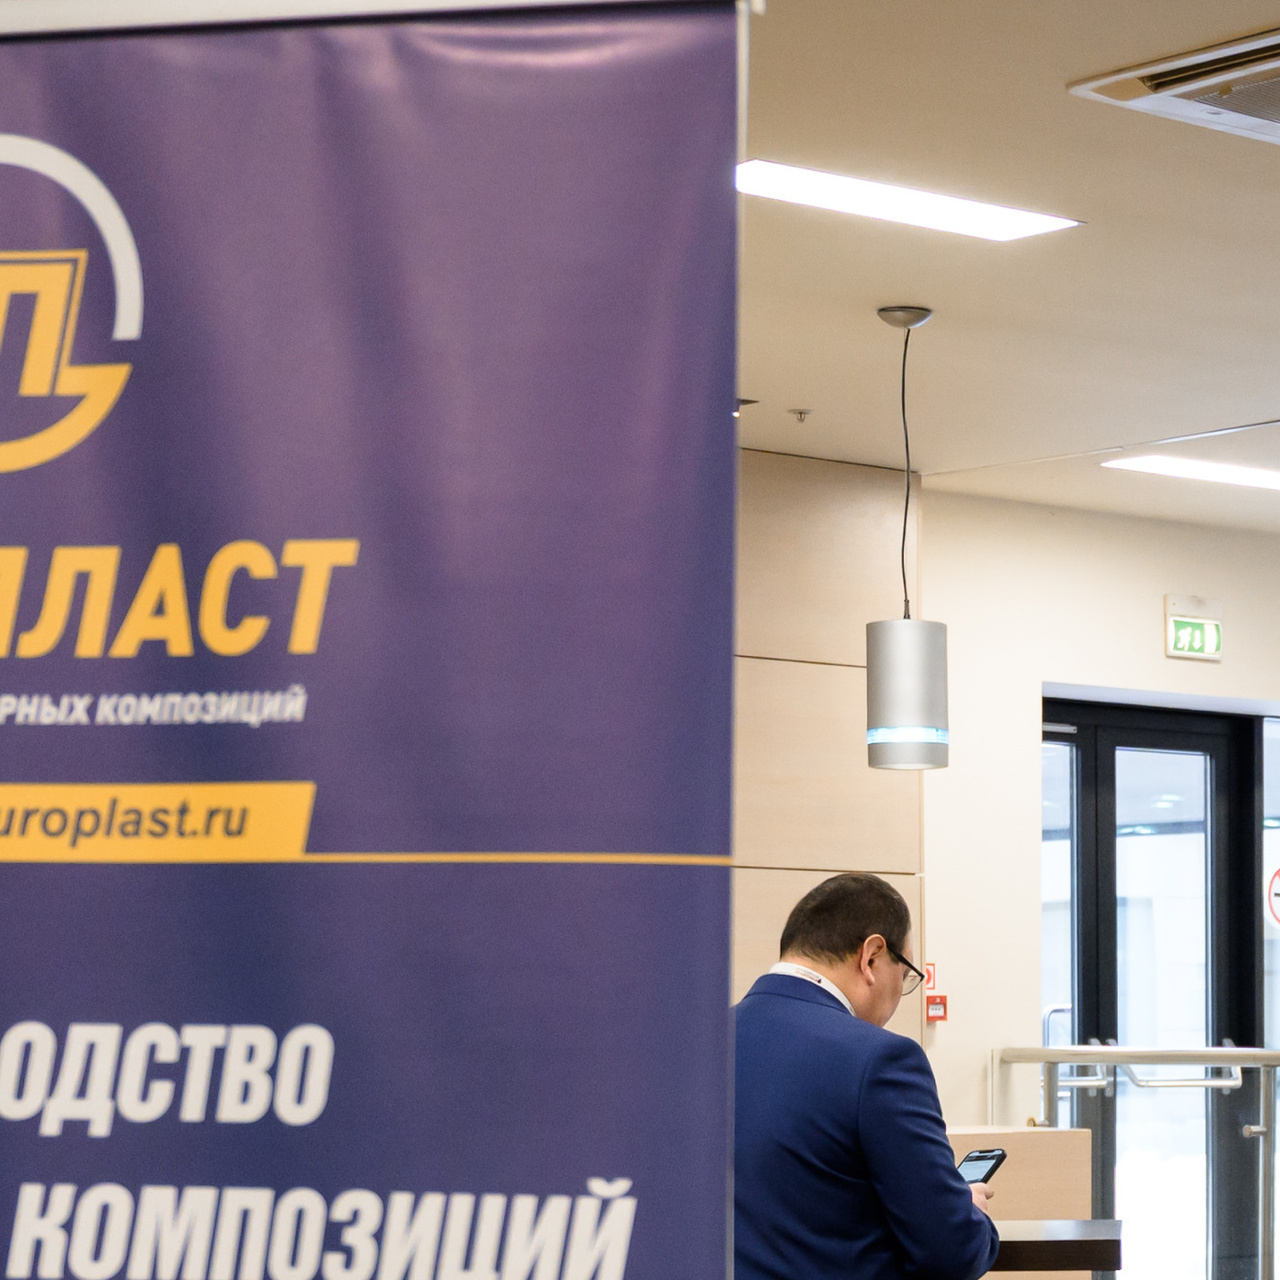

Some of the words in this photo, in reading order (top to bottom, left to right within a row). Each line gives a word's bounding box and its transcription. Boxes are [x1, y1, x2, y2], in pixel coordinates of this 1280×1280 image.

[0, 693, 93, 725] РНЫХ
[95, 684, 307, 728] КОМПОЗИЦИЙ
[0, 1020, 335, 1137] ОДСТВО
